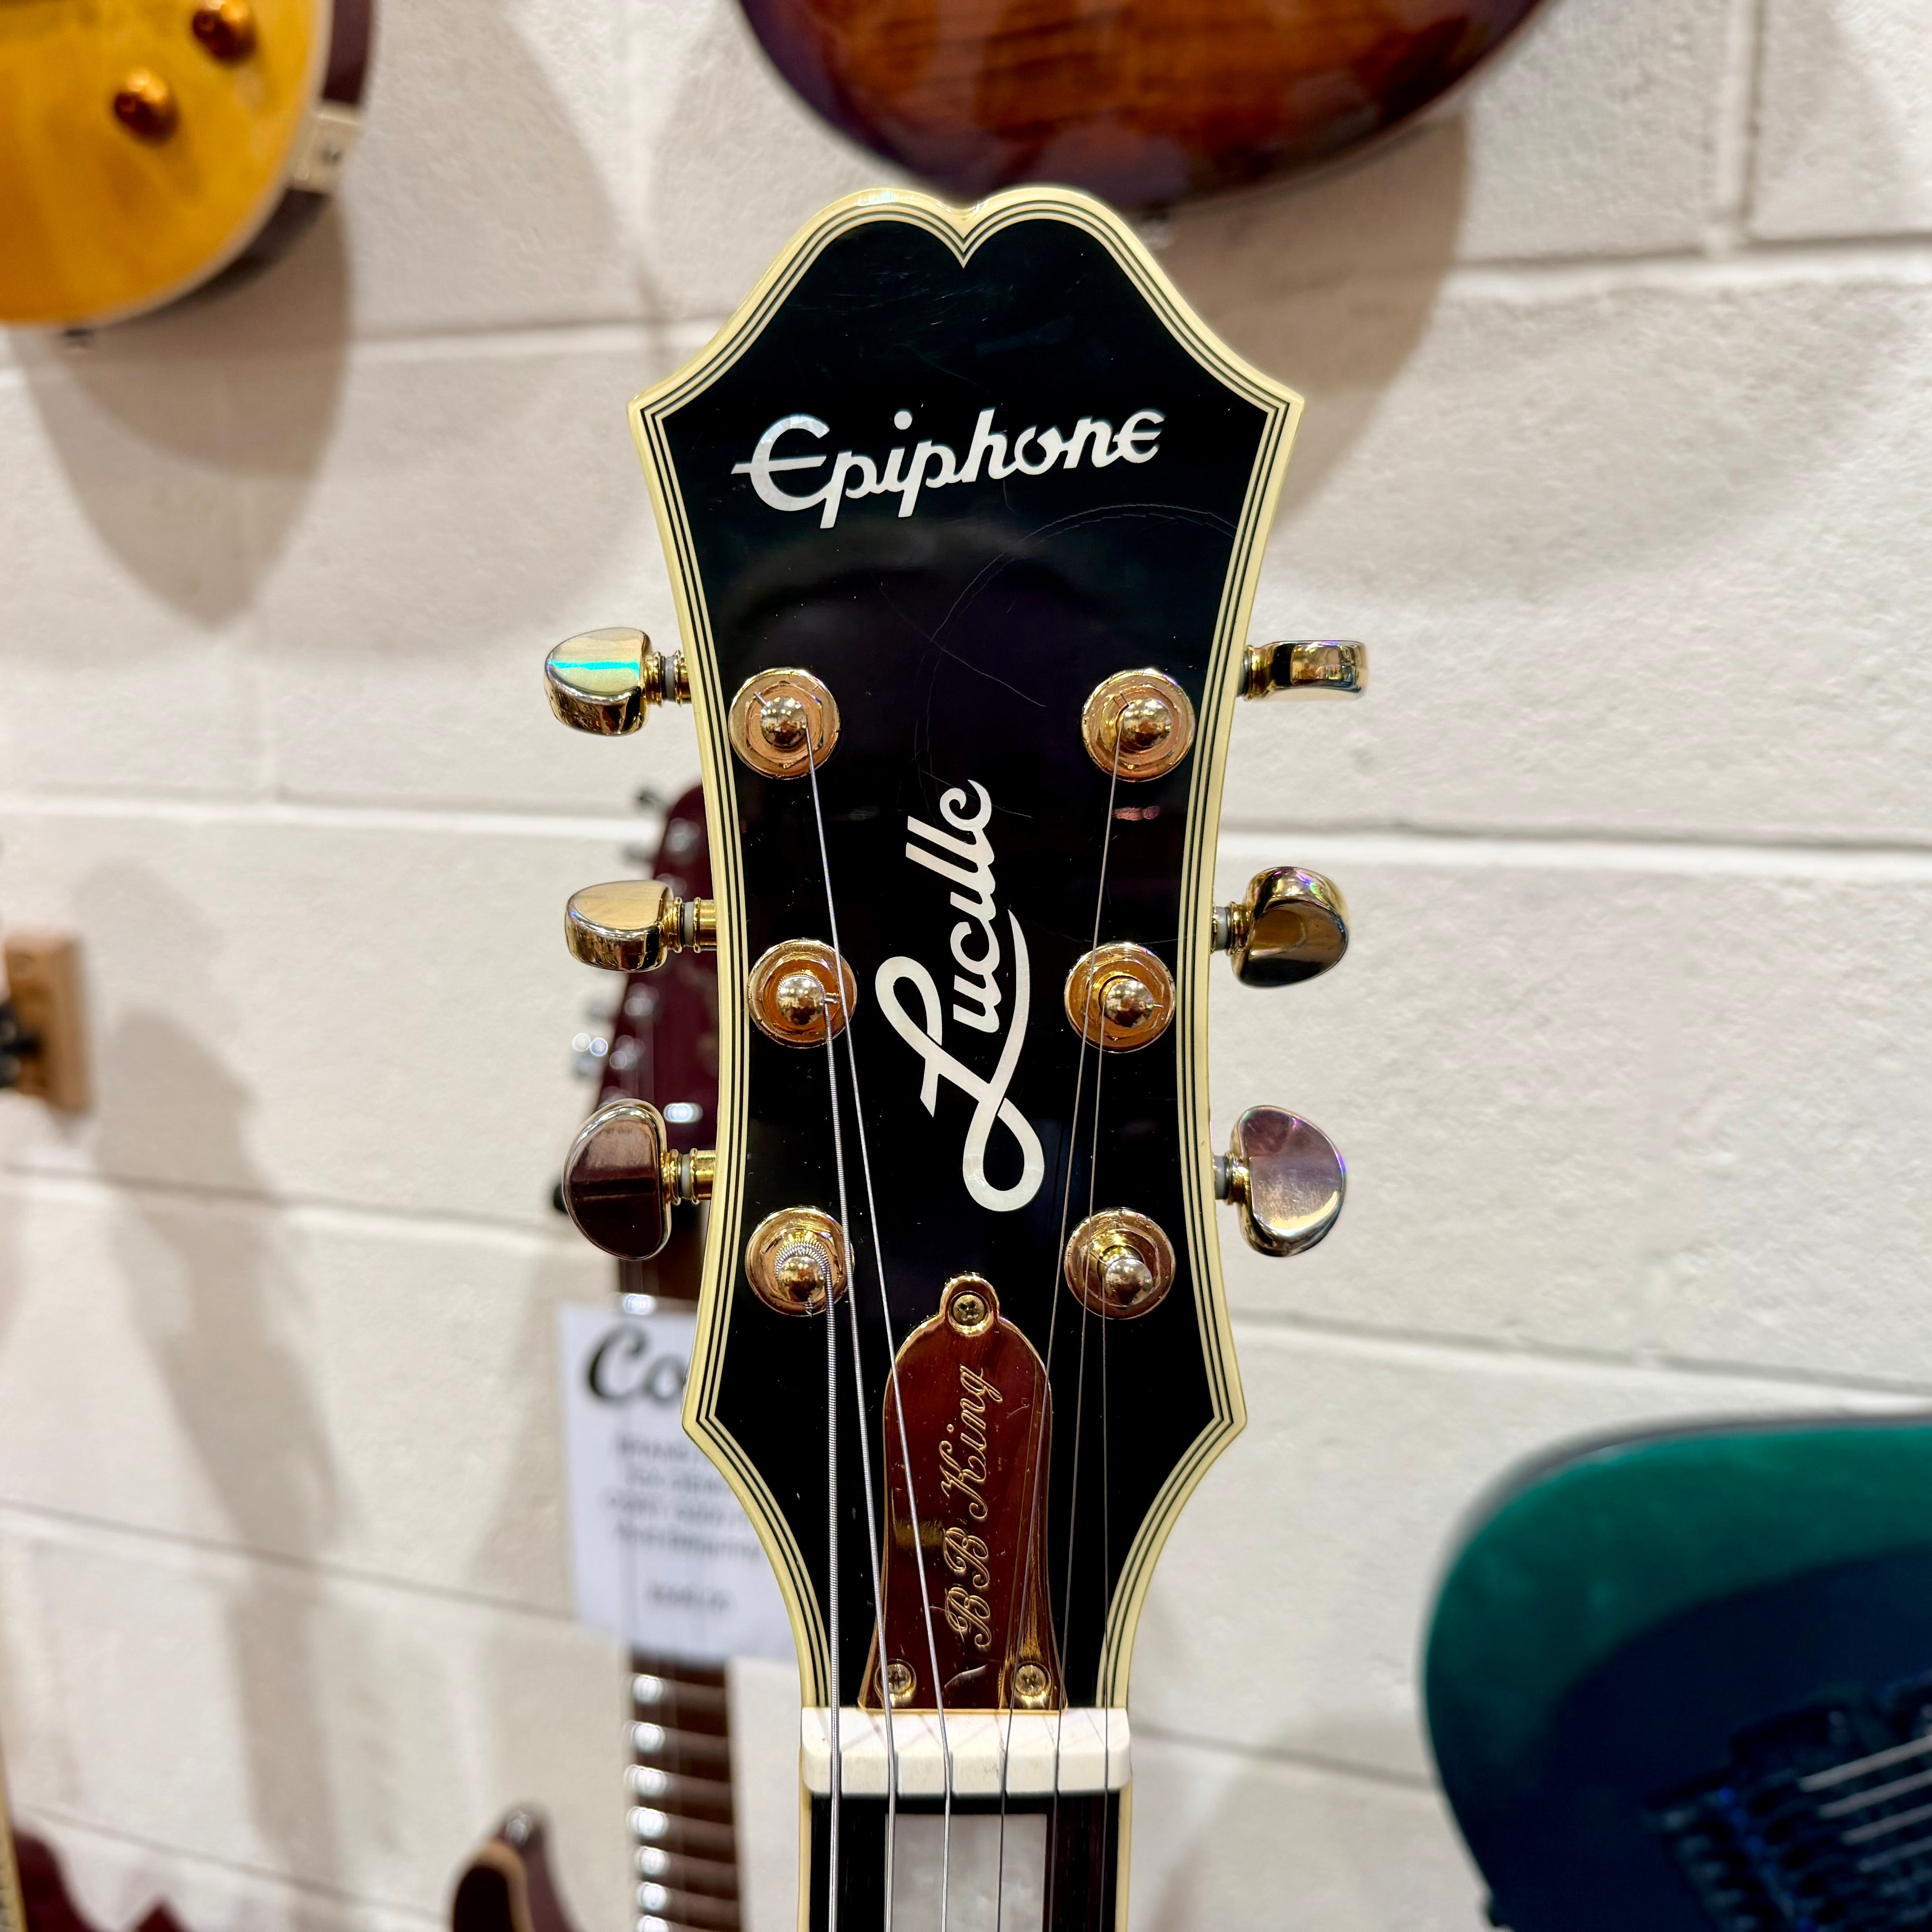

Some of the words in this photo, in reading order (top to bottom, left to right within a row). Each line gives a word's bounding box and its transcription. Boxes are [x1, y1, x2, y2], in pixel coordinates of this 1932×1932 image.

[731, 409, 1166, 529] Epiphone
[875, 779, 1044, 1212] Lucille
[939, 1364, 1003, 1520] King
